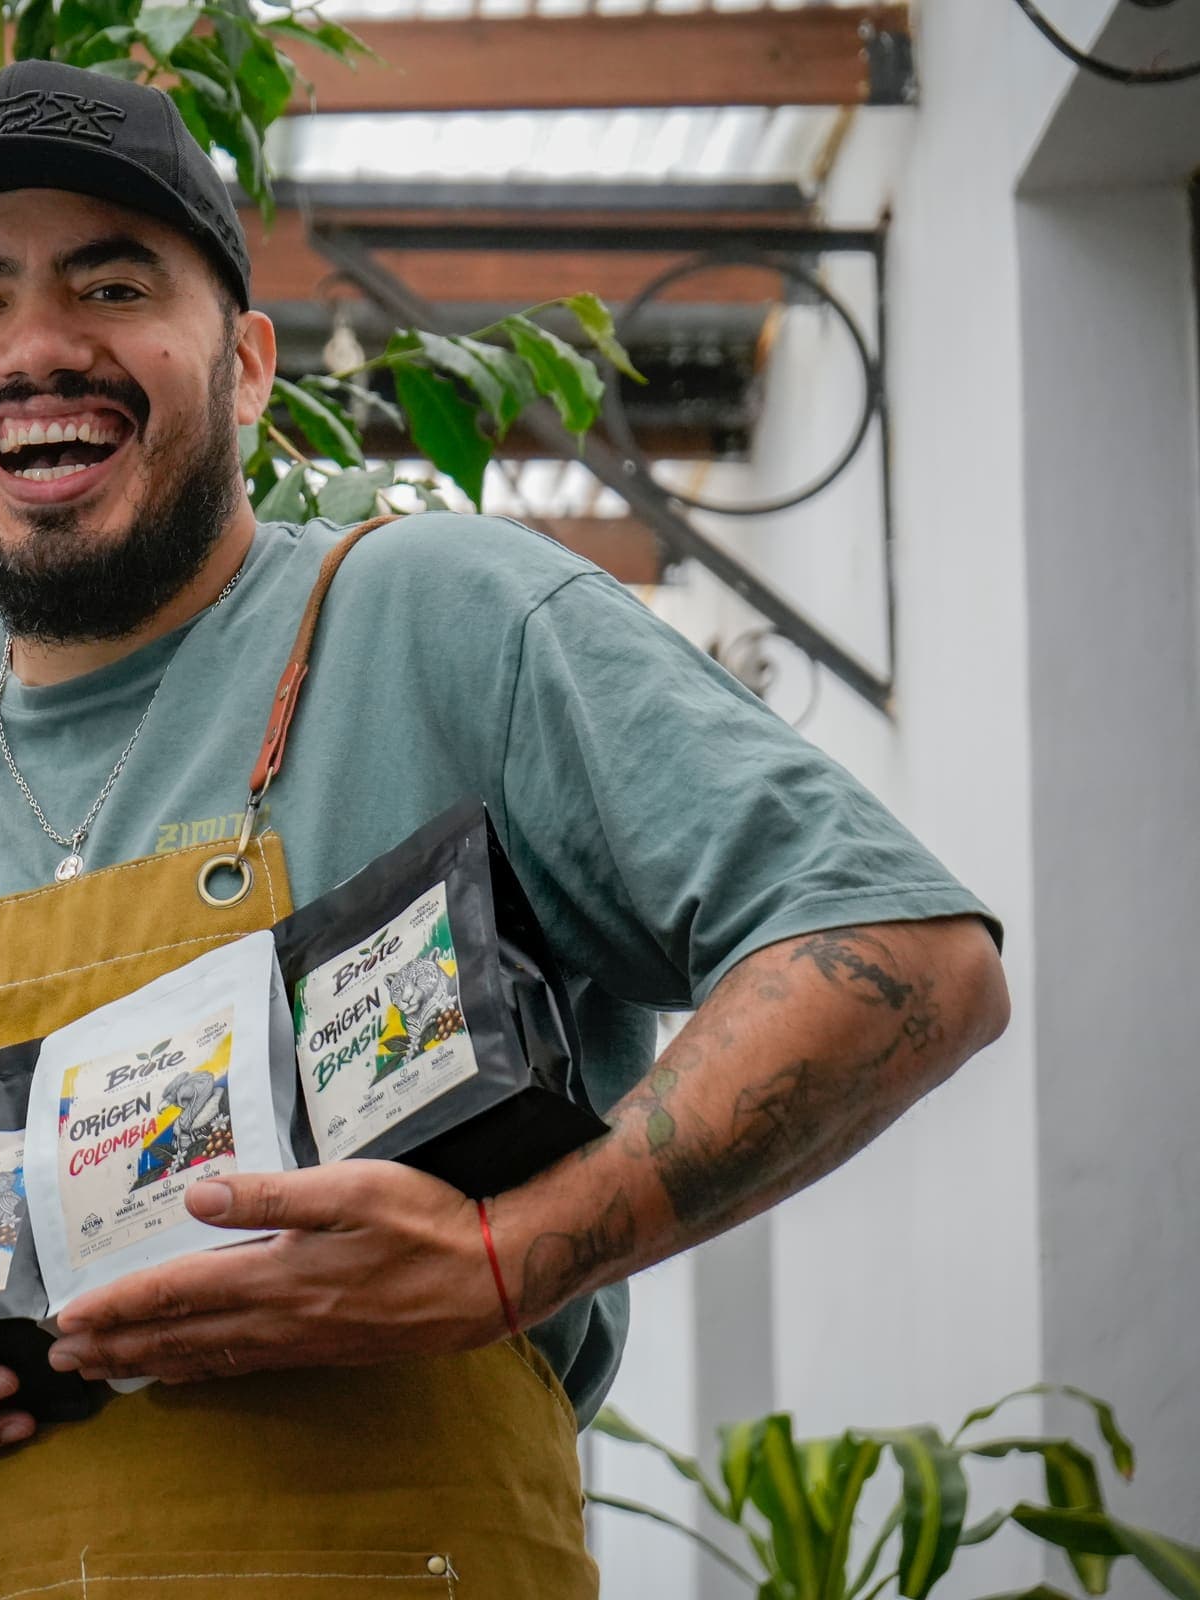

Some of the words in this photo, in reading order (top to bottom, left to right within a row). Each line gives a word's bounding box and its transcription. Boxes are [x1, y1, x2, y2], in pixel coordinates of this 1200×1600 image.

[333, 935, 403, 997] Brote
[103, 1050, 187, 1092] Brote
[80, 1216, 104, 1233] ALTURA
[115, 1200, 145, 1217] VARIETAL
[152, 1183, 185, 1202] BENEFICIO
